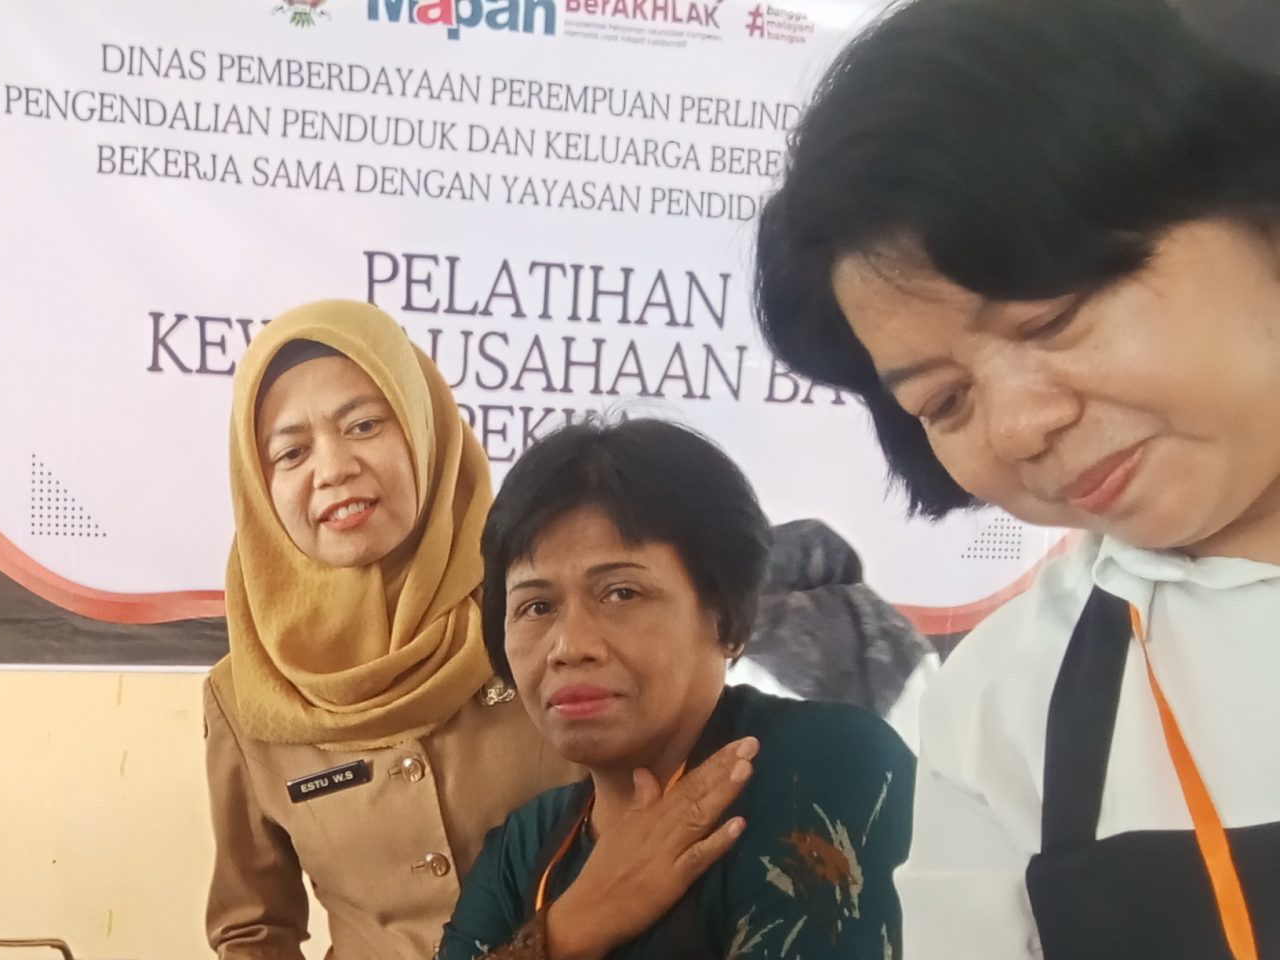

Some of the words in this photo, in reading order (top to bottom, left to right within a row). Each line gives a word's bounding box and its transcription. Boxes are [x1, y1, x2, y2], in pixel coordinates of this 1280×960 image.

[100, 43, 207, 81] DINAS
[217, 53, 482, 104] PEMBERDAYAAN
[490, 76, 671, 122] PEREMPUAN
[4, 84, 270, 138] PENGENDALIAN
[281, 108, 458, 152] PENDUDUK
[467, 124, 535, 158] DAN
[544, 130, 701, 172] KELUARGA
[96, 144, 243, 187] BEKERJA
[251, 156, 346, 193] SAMA
[355, 164, 492, 203] DENGAN
[499, 175, 642, 215] YAYASAN
[362, 249, 732, 332] PELATIHAN
[300, 778, 329, 793] ESTU
[332, 770, 354, 784] W.S
